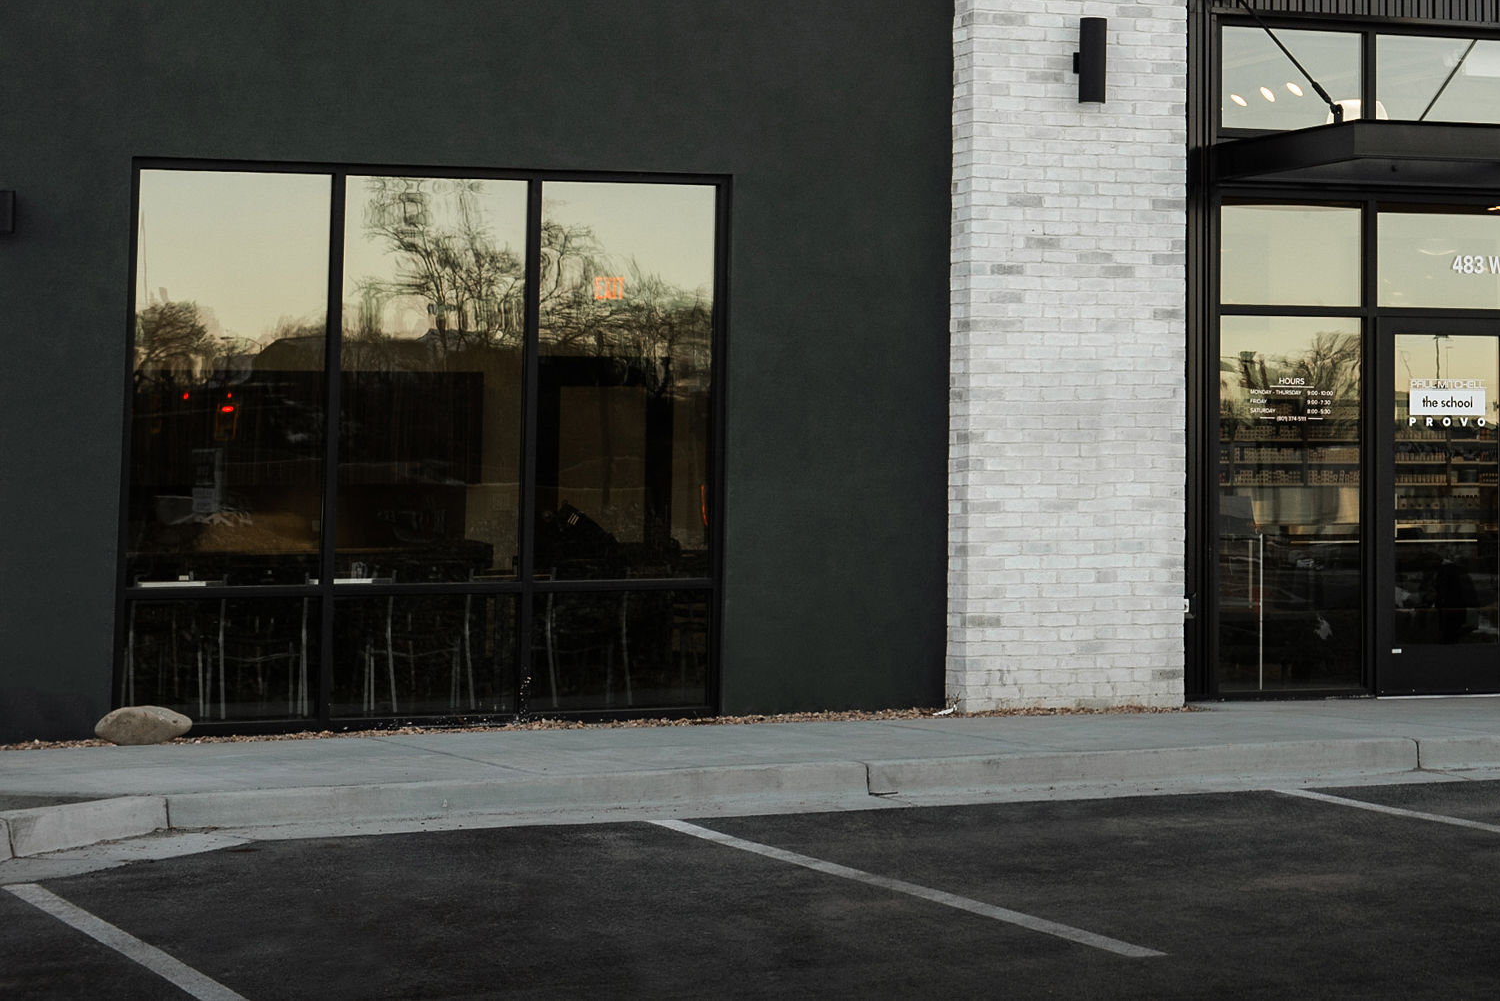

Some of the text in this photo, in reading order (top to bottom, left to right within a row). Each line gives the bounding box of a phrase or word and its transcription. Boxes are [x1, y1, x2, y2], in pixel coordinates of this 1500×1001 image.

[1452, 255, 1484, 274] 483
[1278, 377, 1305, 385] HOURS
[1410, 380, 1484, 389] PAUL MITCHELL
[1422, 395, 1473, 408] the school
[1408, 417, 1486, 427] PROVO
